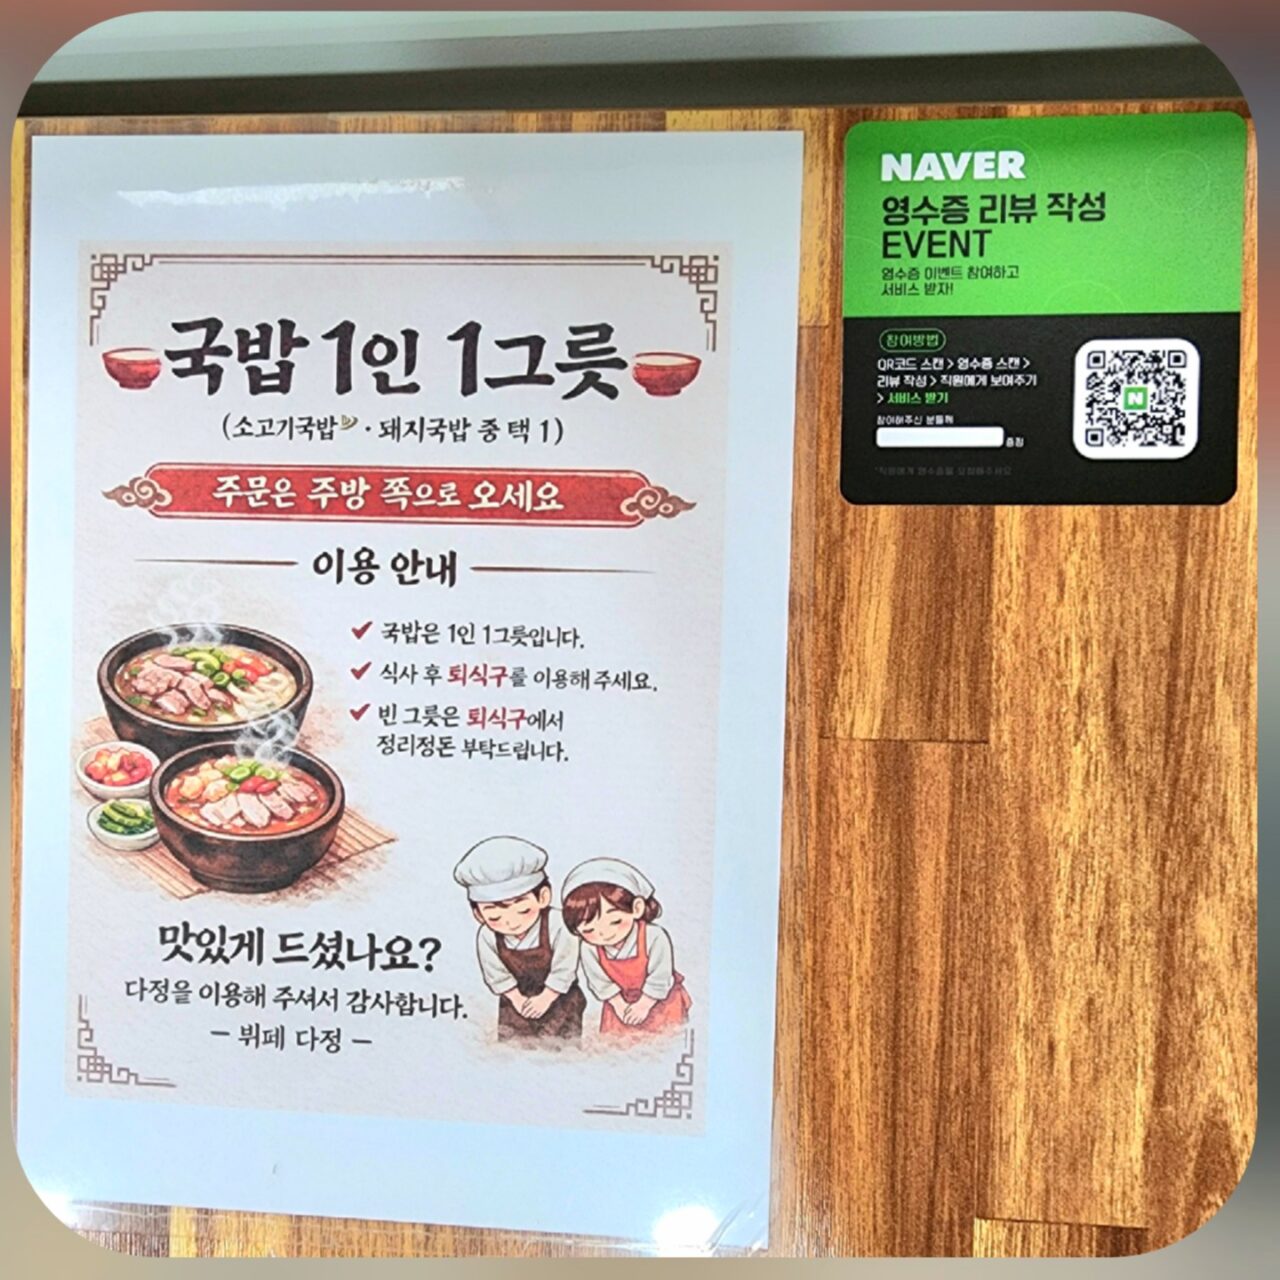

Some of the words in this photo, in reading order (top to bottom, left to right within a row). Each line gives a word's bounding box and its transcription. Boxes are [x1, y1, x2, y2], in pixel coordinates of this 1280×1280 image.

[881, 151, 1026, 182] NAVER
[882, 196, 970, 226] 영수증
[979, 194, 1038, 224] 리뷰
[1047, 192, 1106, 222] 작성
[882, 230, 992, 259] EVENT
[882, 266, 920, 281] 영수증
[924, 266, 962, 280] 이벤트
[967, 265, 1019, 280] 참여하고
[881, 282, 920, 297] 서비스
[924, 282, 954, 296] 받자!
[886, 334, 939, 347] 참여방법
[165, 317, 309, 395] 국밥
[321, 320, 420, 395] 1인
[447, 321, 628, 400] 1그릇
[877, 358, 917, 371] QR코드
[921, 358, 944, 370] 스캔
[957, 357, 992, 370] 영수증
[996, 357, 1020, 370] 스캔
[877, 375, 900, 388] 리뷰
[904, 375, 927, 388] 작성
[940, 375, 987, 387] 직원에게
[990, 374, 1038, 386] 보여주기
[887, 392, 922, 404] 서비스
[925, 392, 948, 404] 받기
[379, 416, 471, 443] 돼지국밥
[478, 418, 500, 443] 중
[508, 418, 529, 444] 택
[541, 418, 563, 445] 1)
[213, 475, 296, 507] 주문은
[307, 477, 370, 510] 주방
[381, 477, 460, 510] 쪽으로
[469, 480, 564, 512] 오세요
[313, 547, 380, 585] 이용
[391, 549, 456, 587] 안내
[382, 620, 440, 644] 국밥은
[448, 622, 475, 645] 1인
[483, 625, 584, 648] 1그릇입니다.
[381, 662, 418, 684] 식사
[424, 664, 442, 686] 후
[448, 663, 527, 687] 퇴식구를
[379, 703, 396, 726] 빈
[403, 705, 460, 727] 그릇은
[467, 706, 563, 731] 퇴식구에서
[377, 734, 456, 758] 정리정돈
[462, 738, 568, 762] 부탁드립니다.
[159, 921, 264, 966] 맛있게
[273, 931, 441, 972] 드셨나요?
[125, 977, 192, 1004] 다정을
[199, 981, 265, 1008] 이용해
[273, 986, 338, 1012] 주셔서
[347, 989, 467, 1019] 감사합니다.
[239, 1023, 284, 1050] 뷔페
[296, 1026, 341, 1053] 다정
